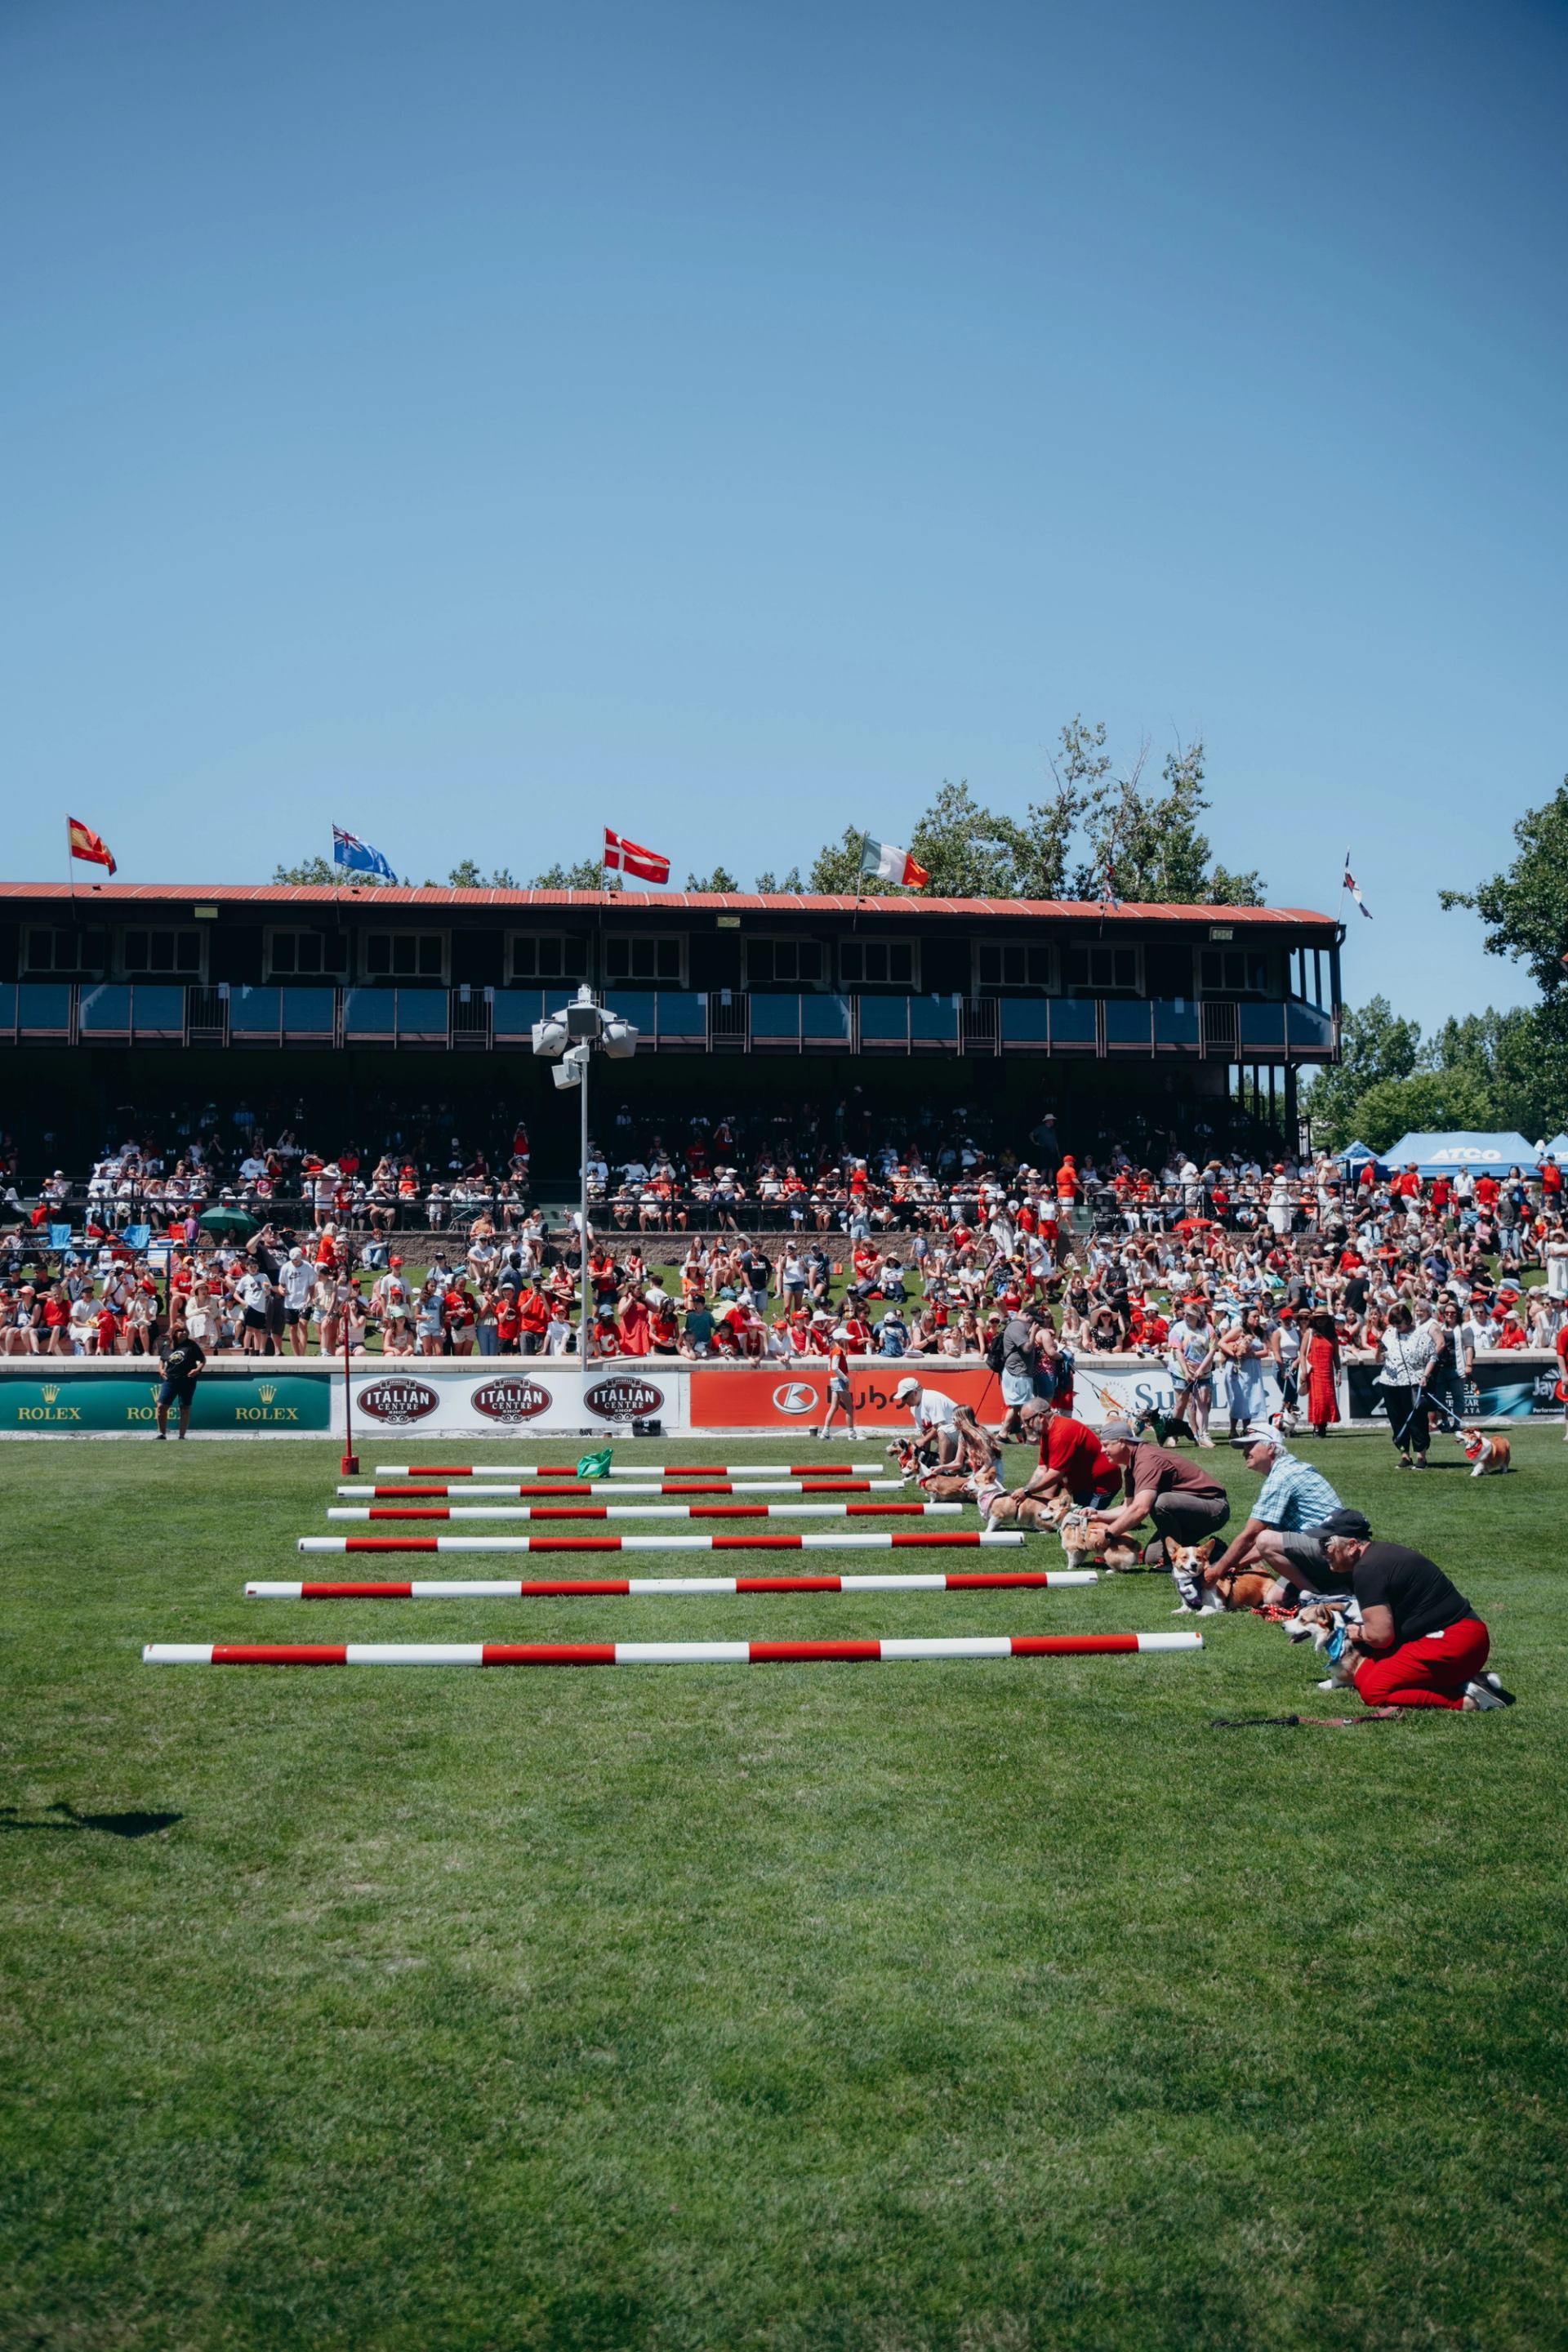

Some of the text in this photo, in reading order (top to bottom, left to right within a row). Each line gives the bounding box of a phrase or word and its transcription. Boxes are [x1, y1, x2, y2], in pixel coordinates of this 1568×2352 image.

[1430, 1147, 1502, 1160] ATCO
[1532, 1376, 1556, 1401] Jay
[368, 1390, 429, 1405] ITALIAN
[481, 1389, 542, 1404] ITALIAN
[594, 1389, 654, 1404] ITALIAN
[826, 1385, 907, 1410] ubo
[1135, 1383, 1175, 1410] Su
[18, 1407, 82, 1420] ROLEX
[127, 1407, 181, 1420] ROE
[234, 1407, 299, 1420] ROLEX
[1178, 1578, 1198, 1600] 5
